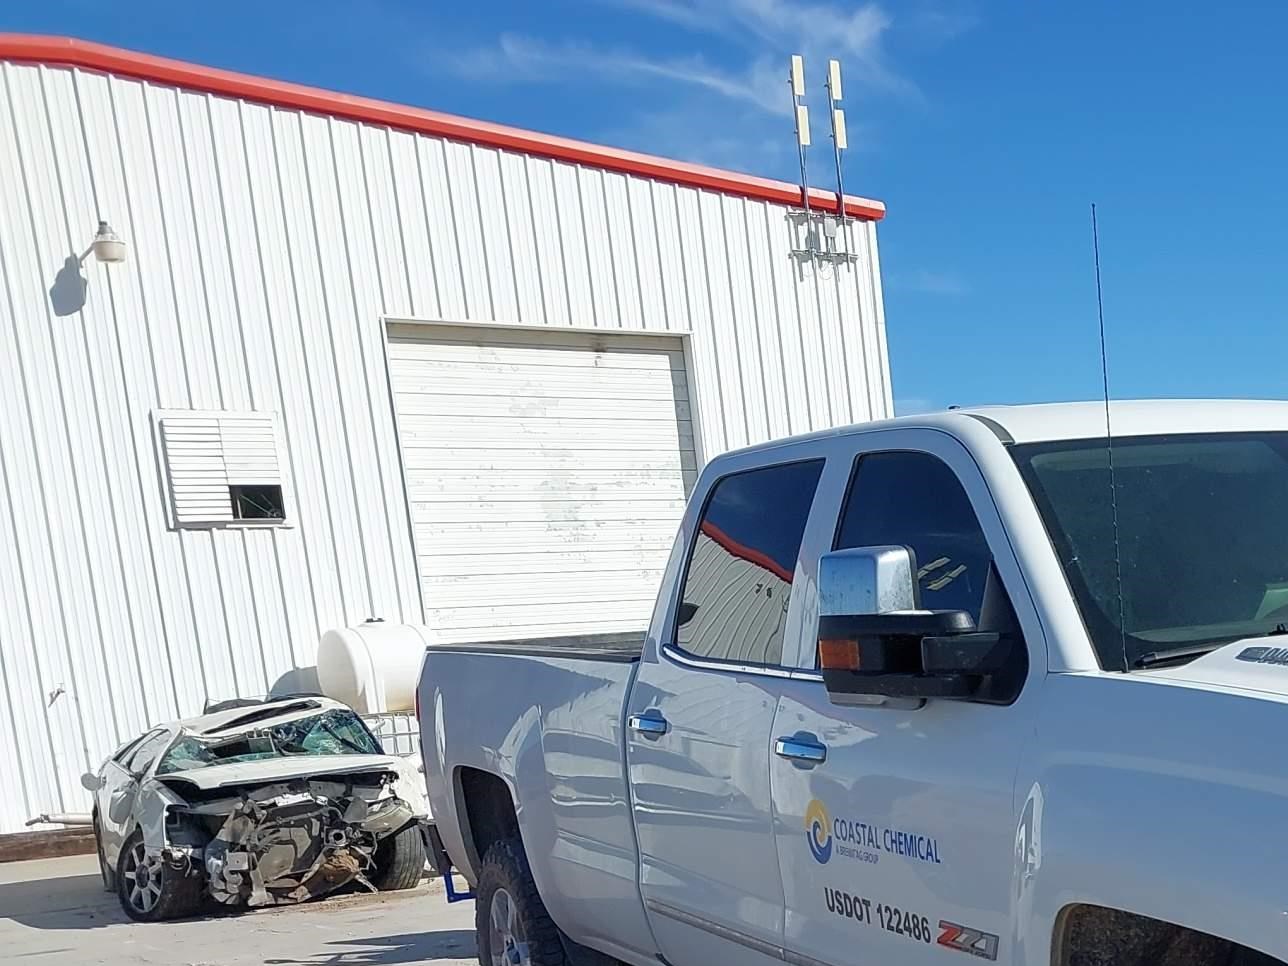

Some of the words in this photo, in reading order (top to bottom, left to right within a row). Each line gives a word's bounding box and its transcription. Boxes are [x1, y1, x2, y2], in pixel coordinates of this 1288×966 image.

[833, 818, 881, 850] COASTAL
[883, 829, 941, 864] CHEMICAL
[824, 887, 871, 924] USDOT
[876, 903, 931, 944] 122486
